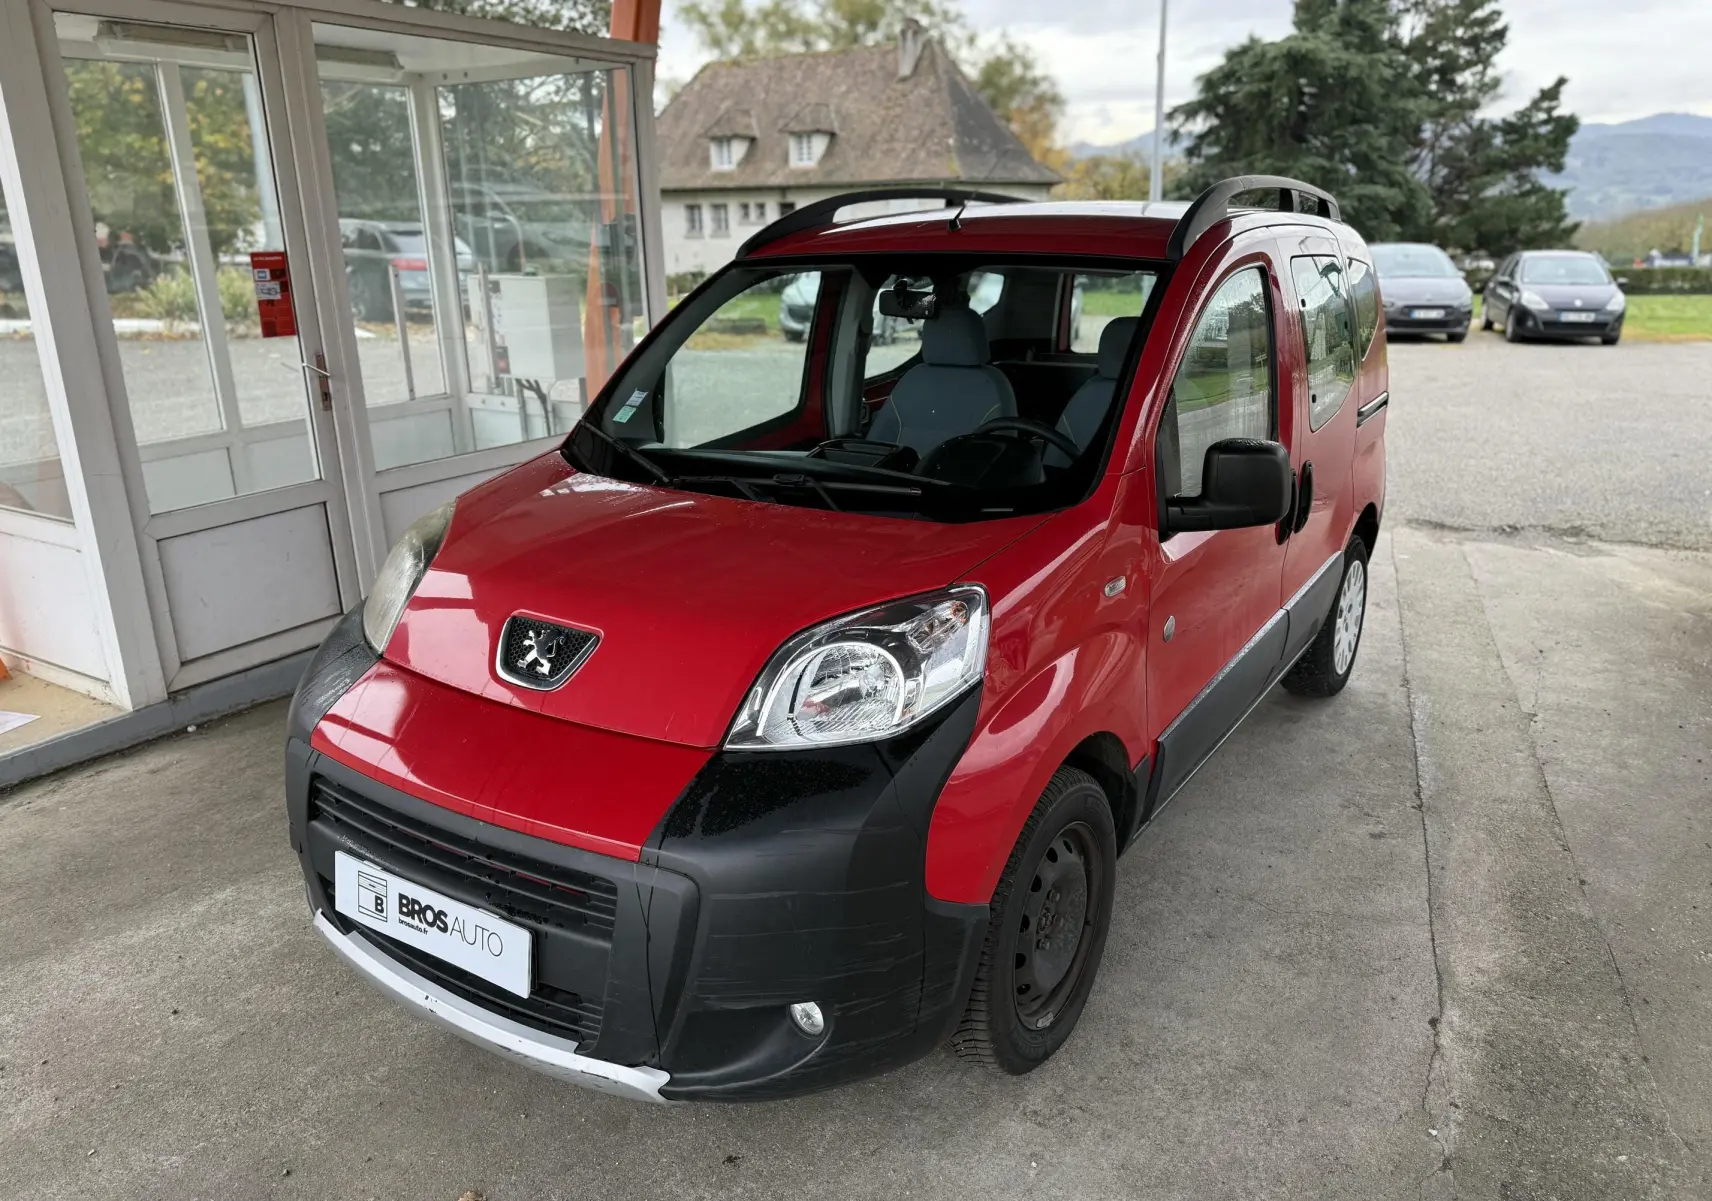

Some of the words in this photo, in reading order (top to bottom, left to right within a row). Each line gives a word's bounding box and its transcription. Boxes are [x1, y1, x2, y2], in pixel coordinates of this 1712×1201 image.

[374, 894, 384, 914] B
[398, 892, 449, 934] BROS
[450, 916, 503, 957] AUTO
[398, 917, 428, 935] brosauto.fr
